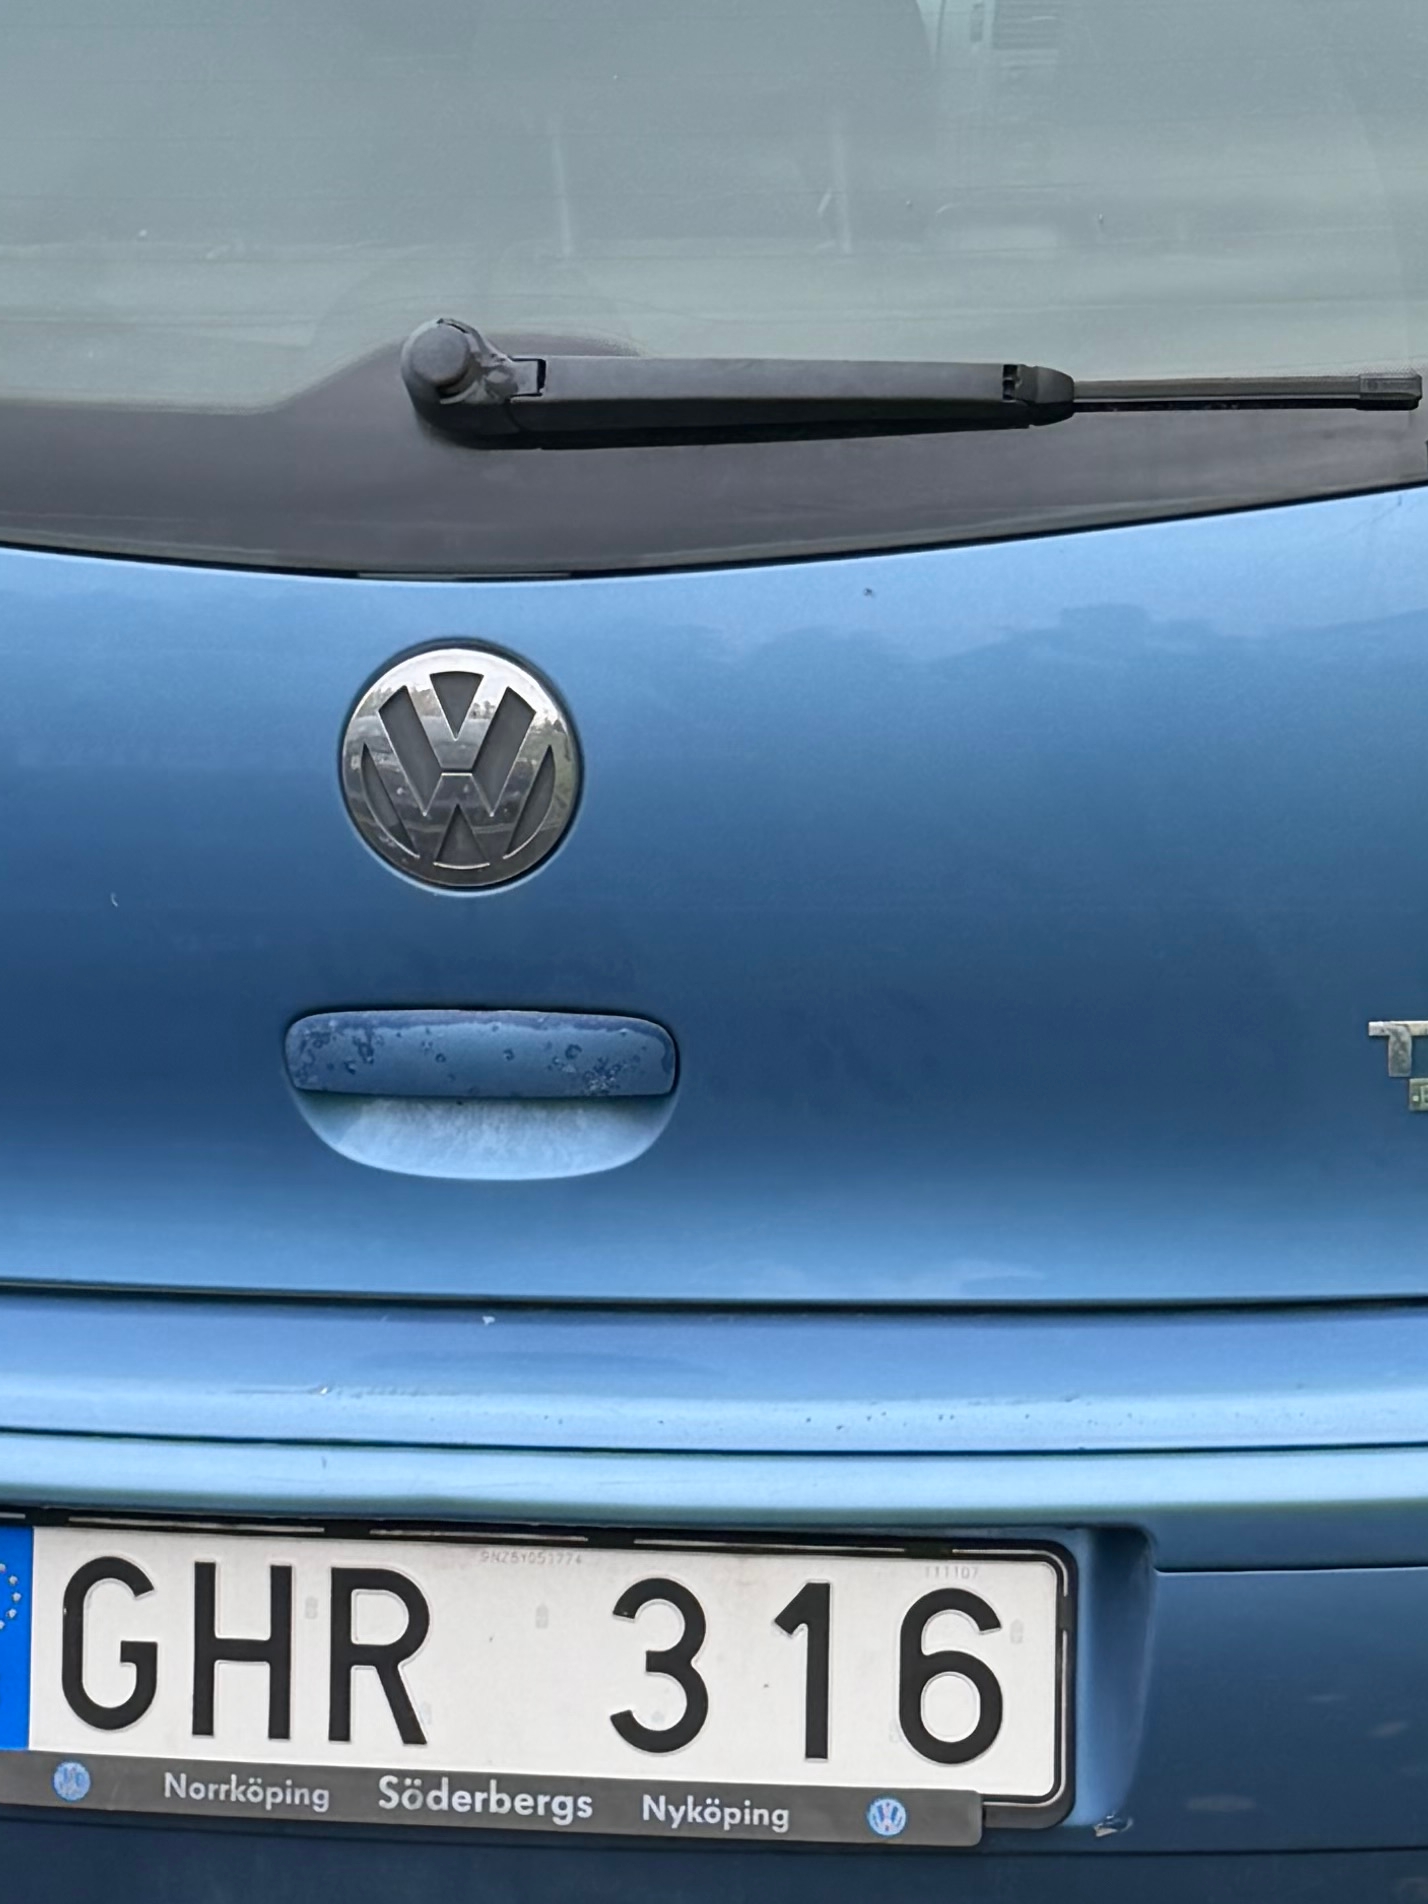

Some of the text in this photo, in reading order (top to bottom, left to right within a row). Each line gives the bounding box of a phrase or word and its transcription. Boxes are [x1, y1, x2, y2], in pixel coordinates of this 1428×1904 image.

[62, 1556, 1003, 1764] GHR 316
[164, 1771, 790, 1833] Norrköping Söderbergs Nyköping
